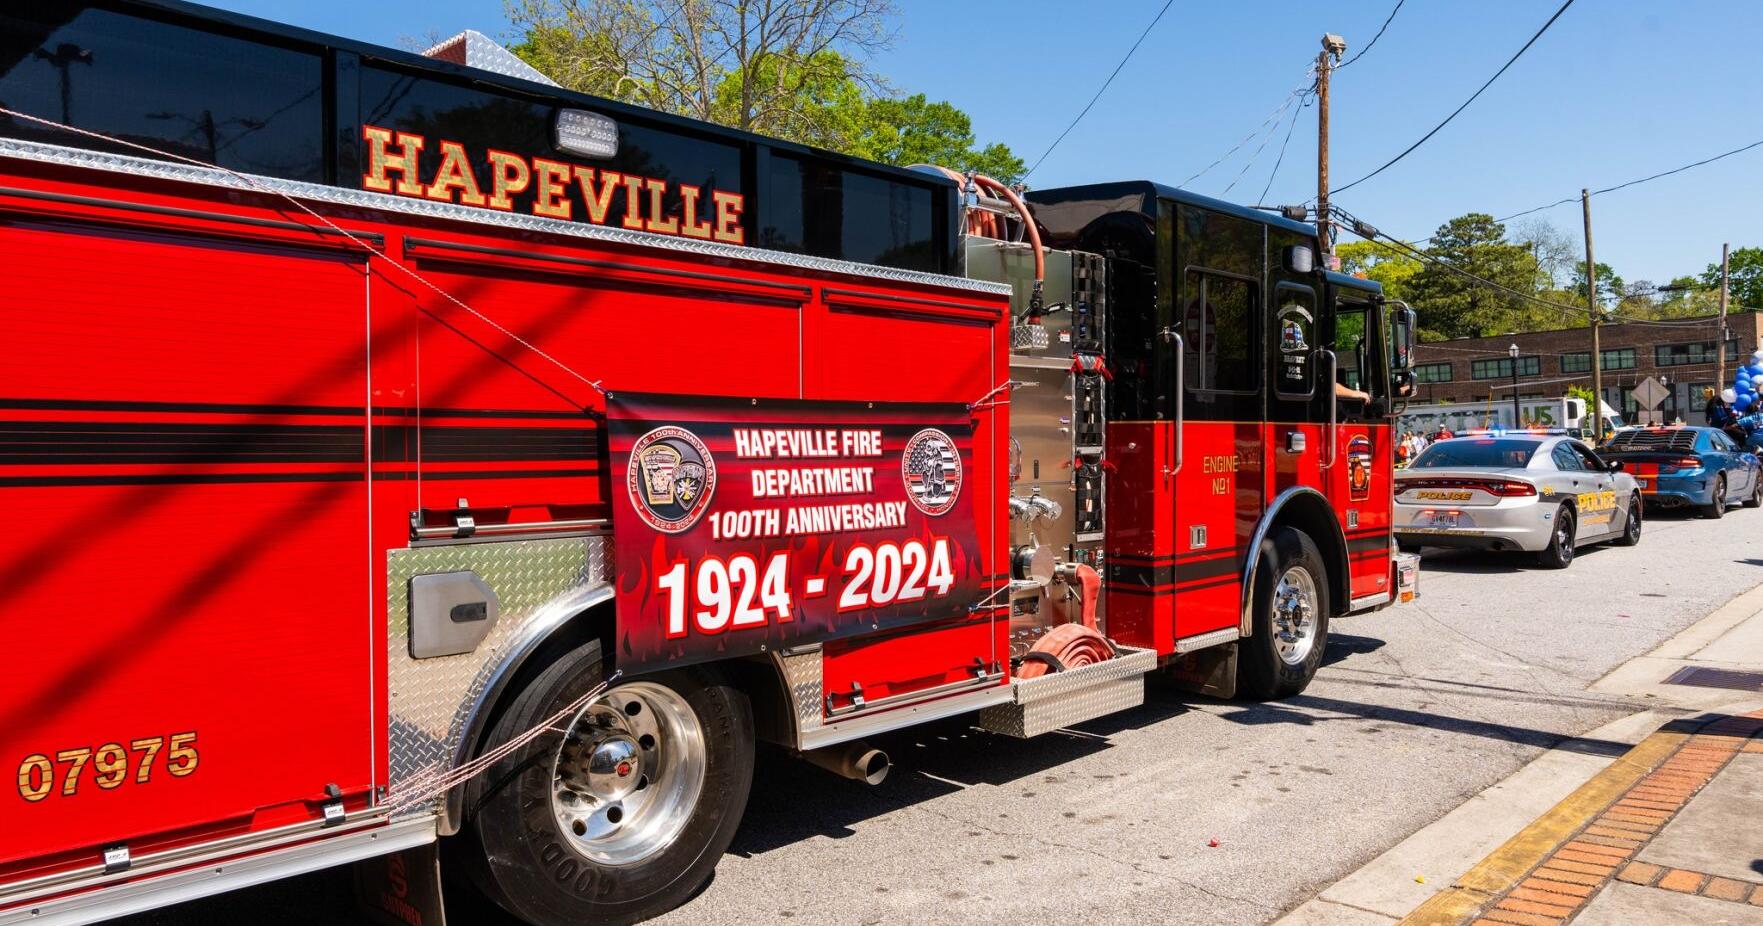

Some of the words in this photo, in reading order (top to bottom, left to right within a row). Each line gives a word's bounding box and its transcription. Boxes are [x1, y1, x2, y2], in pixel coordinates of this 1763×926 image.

[363, 124, 745, 245] HAPEVILLE
[734, 429, 838, 458] HAPEVILLE
[842, 430, 883, 457] FIRE
[1203, 455, 1239, 474] ENGINE
[751, 466, 875, 498] DEPARTMENT
[1416, 490, 1473, 501] POLICE
[1577, 490, 1617, 513] POLICE
[708, 509, 780, 540] 100TH
[785, 501, 909, 536] ANNIVERSARY
[657, 552, 793, 637] 1924
[838, 537, 955, 612] 2024
[17, 731, 199, 803] 07975
